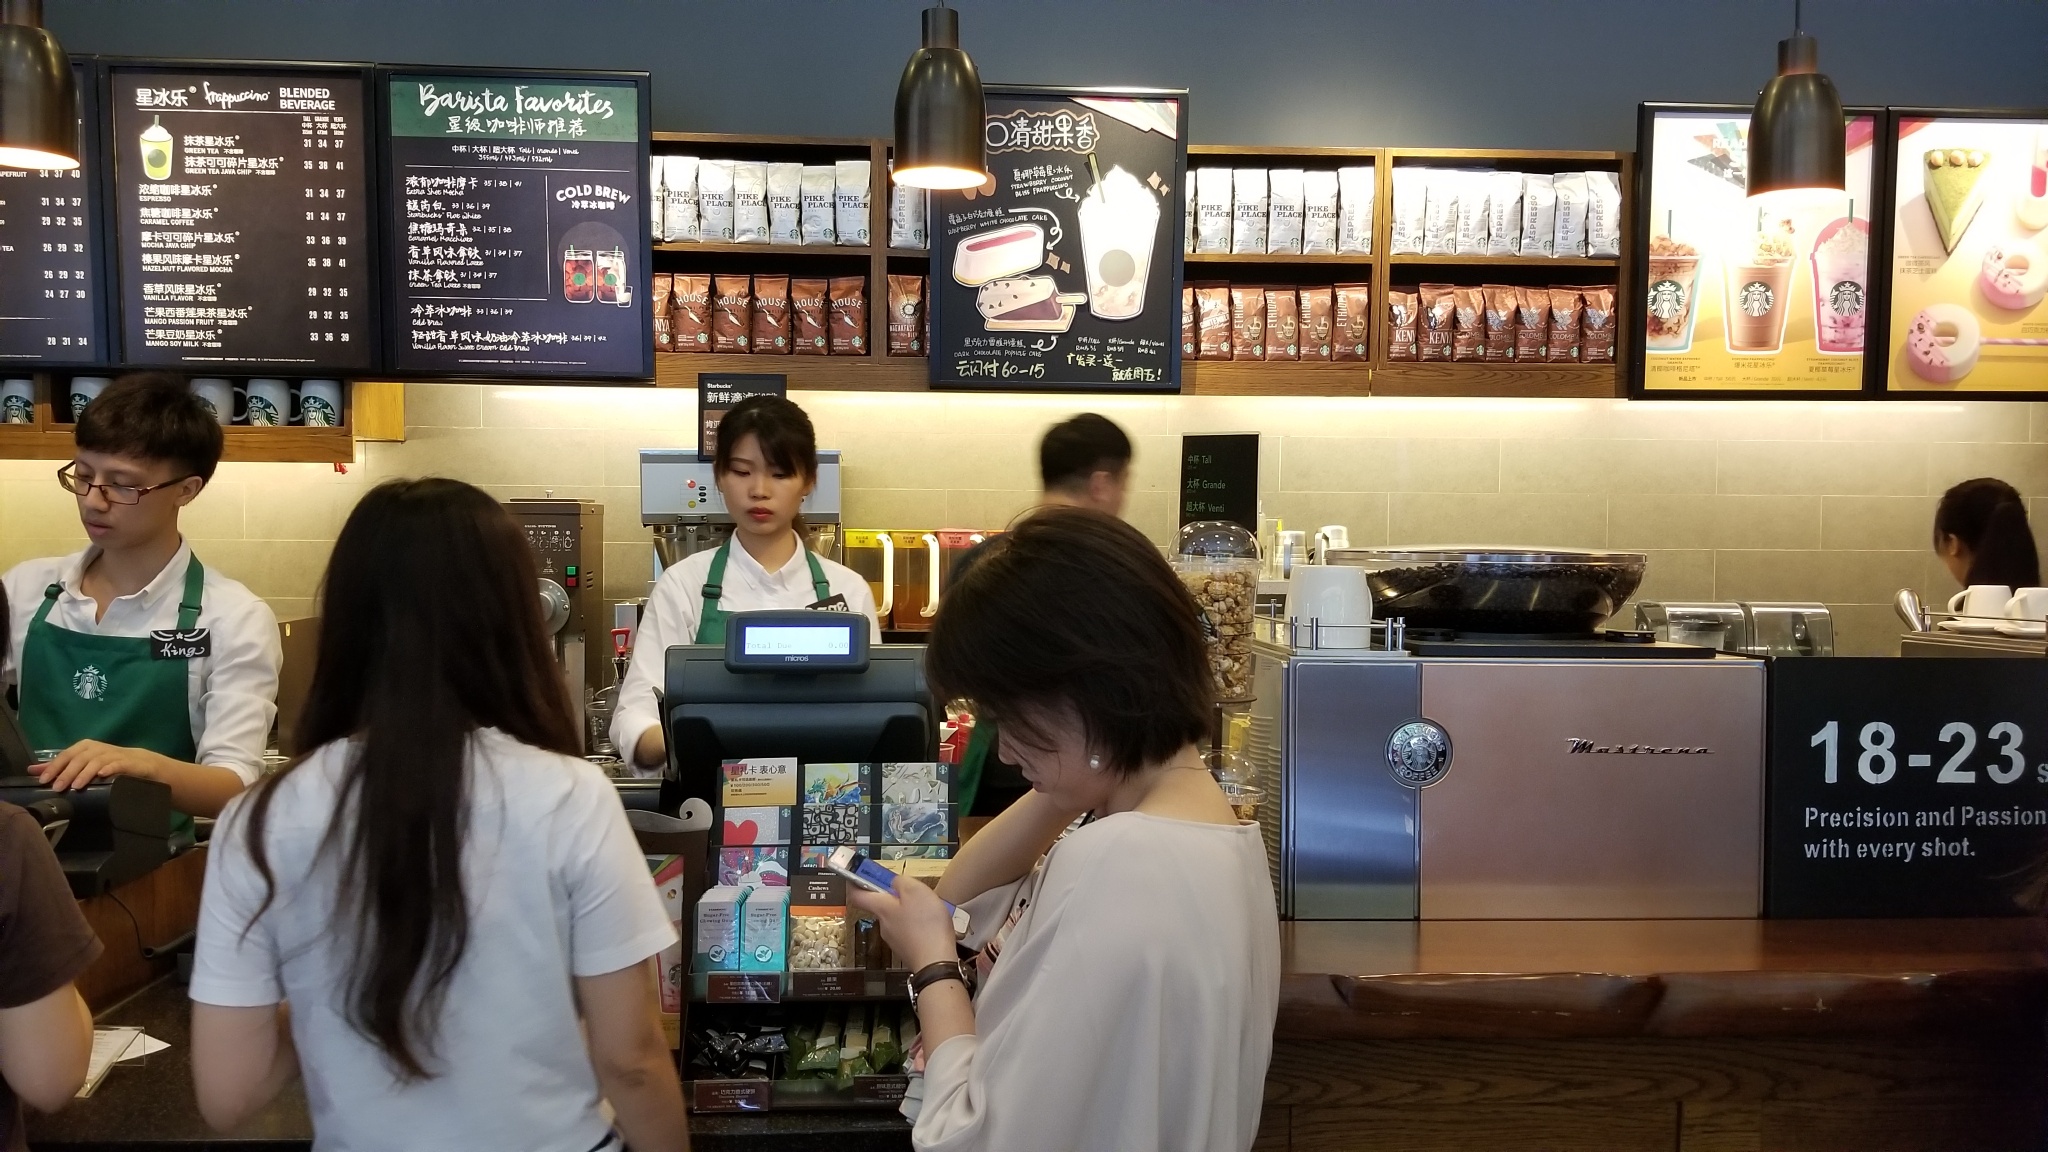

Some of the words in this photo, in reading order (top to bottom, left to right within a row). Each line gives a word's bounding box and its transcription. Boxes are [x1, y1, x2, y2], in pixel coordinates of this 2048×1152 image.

[279, 87, 331, 99] BLENDED
[279, 99, 336, 111] BEVERAGE
[419, 83, 509, 117] Barista
[514, 85, 614, 120] Favorites
[446, 116, 588, 138] 星级咖啡师推荐
[303, 139, 312, 148] 31
[317, 139, 327, 148] 34
[334, 139, 344, 148] 37
[303, 161, 312, 170] 35
[335, 161, 344, 170] 41
[40, 170, 48, 178] 34
[55, 170, 63, 178] 37
[71, 170, 80, 178] 40
[556, 184, 592, 202] COLD
[595, 184, 631, 204] BREW
[667, 190, 690, 198] PIKE
[706, 200, 734, 208] PLACE
[56, 216, 66, 226] 32
[73, 216, 82, 226] 35
[307, 258, 316, 267] 35
[338, 258, 346, 267] 41
[676, 294, 709, 306] HOUSE
[717, 296, 749, 308] HOUSE
[756, 298, 787, 309] HOUSE
[794, 298, 825, 310] HOUSE
[832, 297, 863, 309] HOUSE
[195, 318, 214, 326] FRUIT
[62, 336, 71, 346] 31
[78, 336, 88, 346] 34
[1201, 455, 1212, 464] Tall
[1186, 479, 1200, 490] 大杯
[1202, 480, 1226, 490] Grande
[1207, 503, 1225, 513] Venti
[160, 643, 205, 658] King
[1566, 738, 1715, 754] Mastrena
[1811, 720, 2026, 784] 18-23
[1399, 765, 1438, 781] COFFEE
[1805, 807, 1909, 828] Precision
[1915, 806, 1954, 826] and
[1961, 806, 2047, 827] Passion
[1804, 838, 1850, 858] with
[1856, 840, 1916, 863] every
[1921, 837, 1976, 857] shot.
